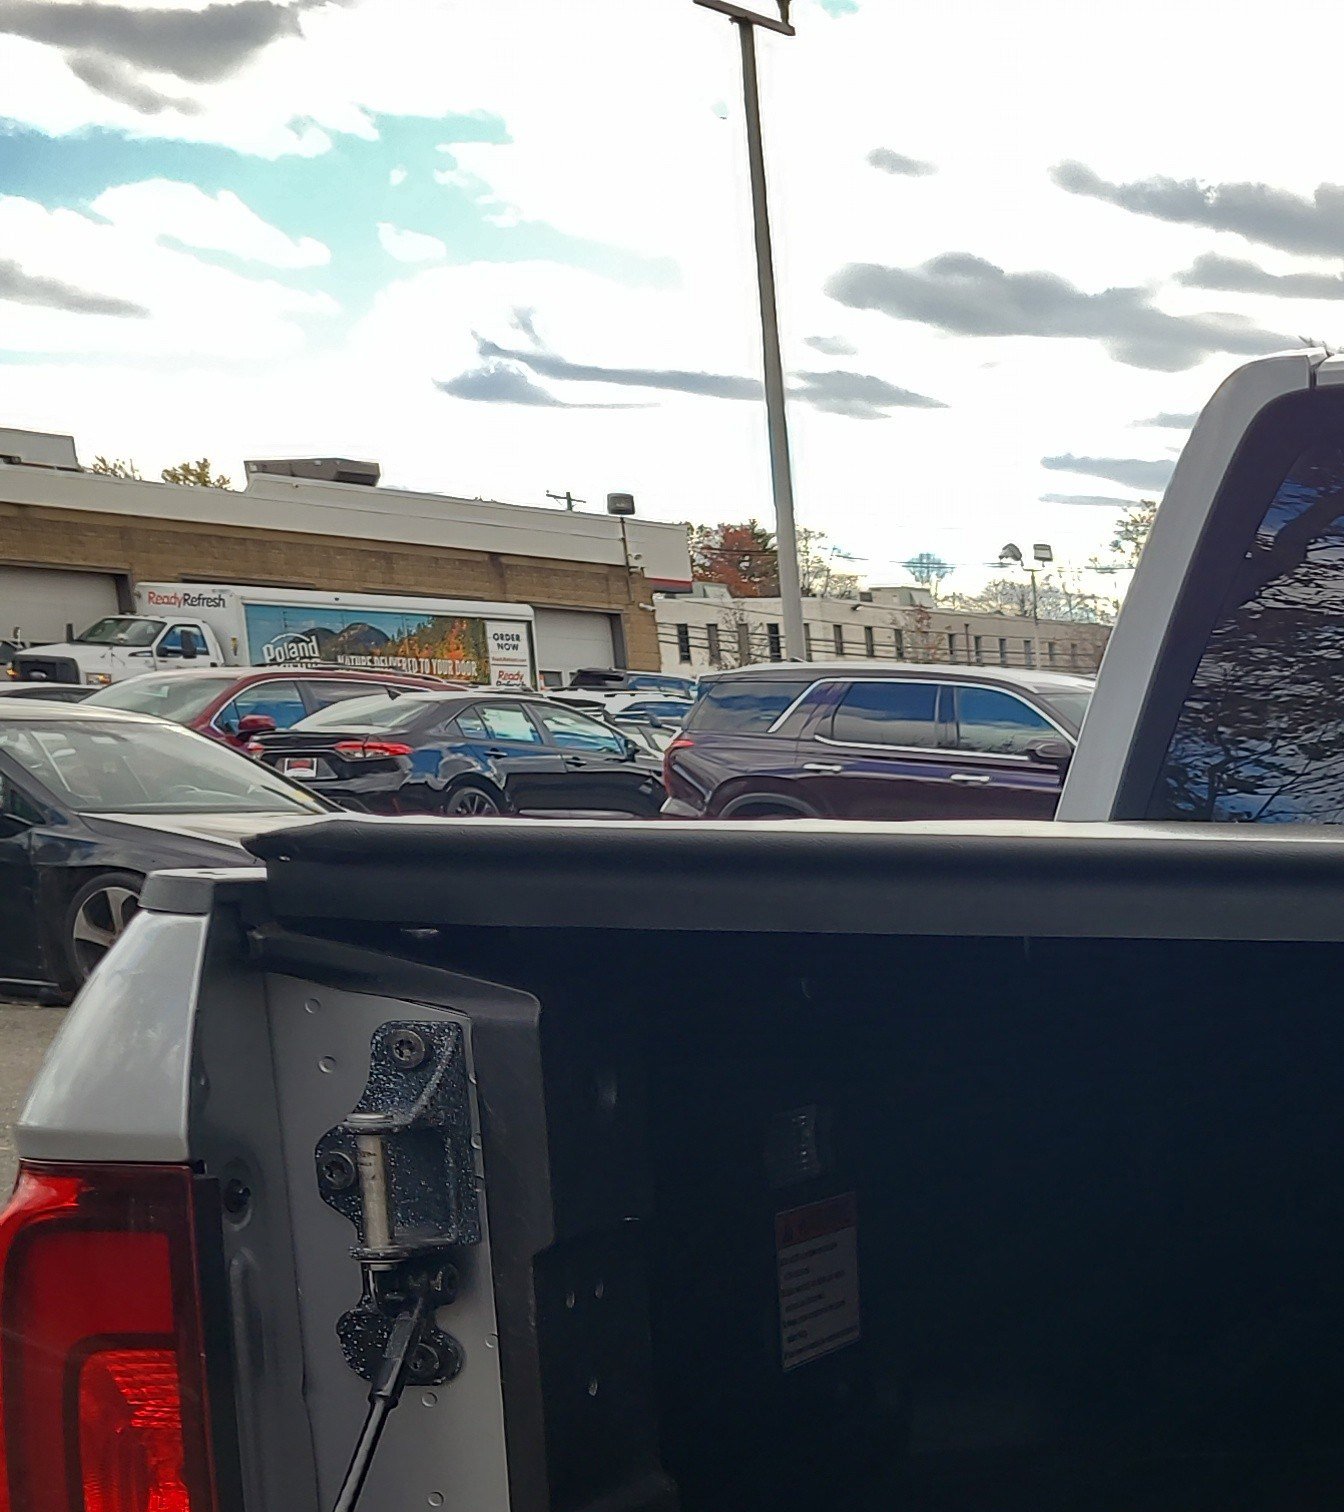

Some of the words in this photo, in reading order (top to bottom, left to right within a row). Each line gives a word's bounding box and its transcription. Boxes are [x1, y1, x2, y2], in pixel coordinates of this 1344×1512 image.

[148, 592, 226, 608] ReadyRefresh
[492, 633, 520, 642] ORDER
[262, 636, 320, 663] Poland
[496, 643, 519, 651] NOW
[419, 658, 430, 674] TO
[432, 659, 454, 675] YOUR
[455, 660, 478, 676] DOOR
[498, 671, 525, 682] Ready
